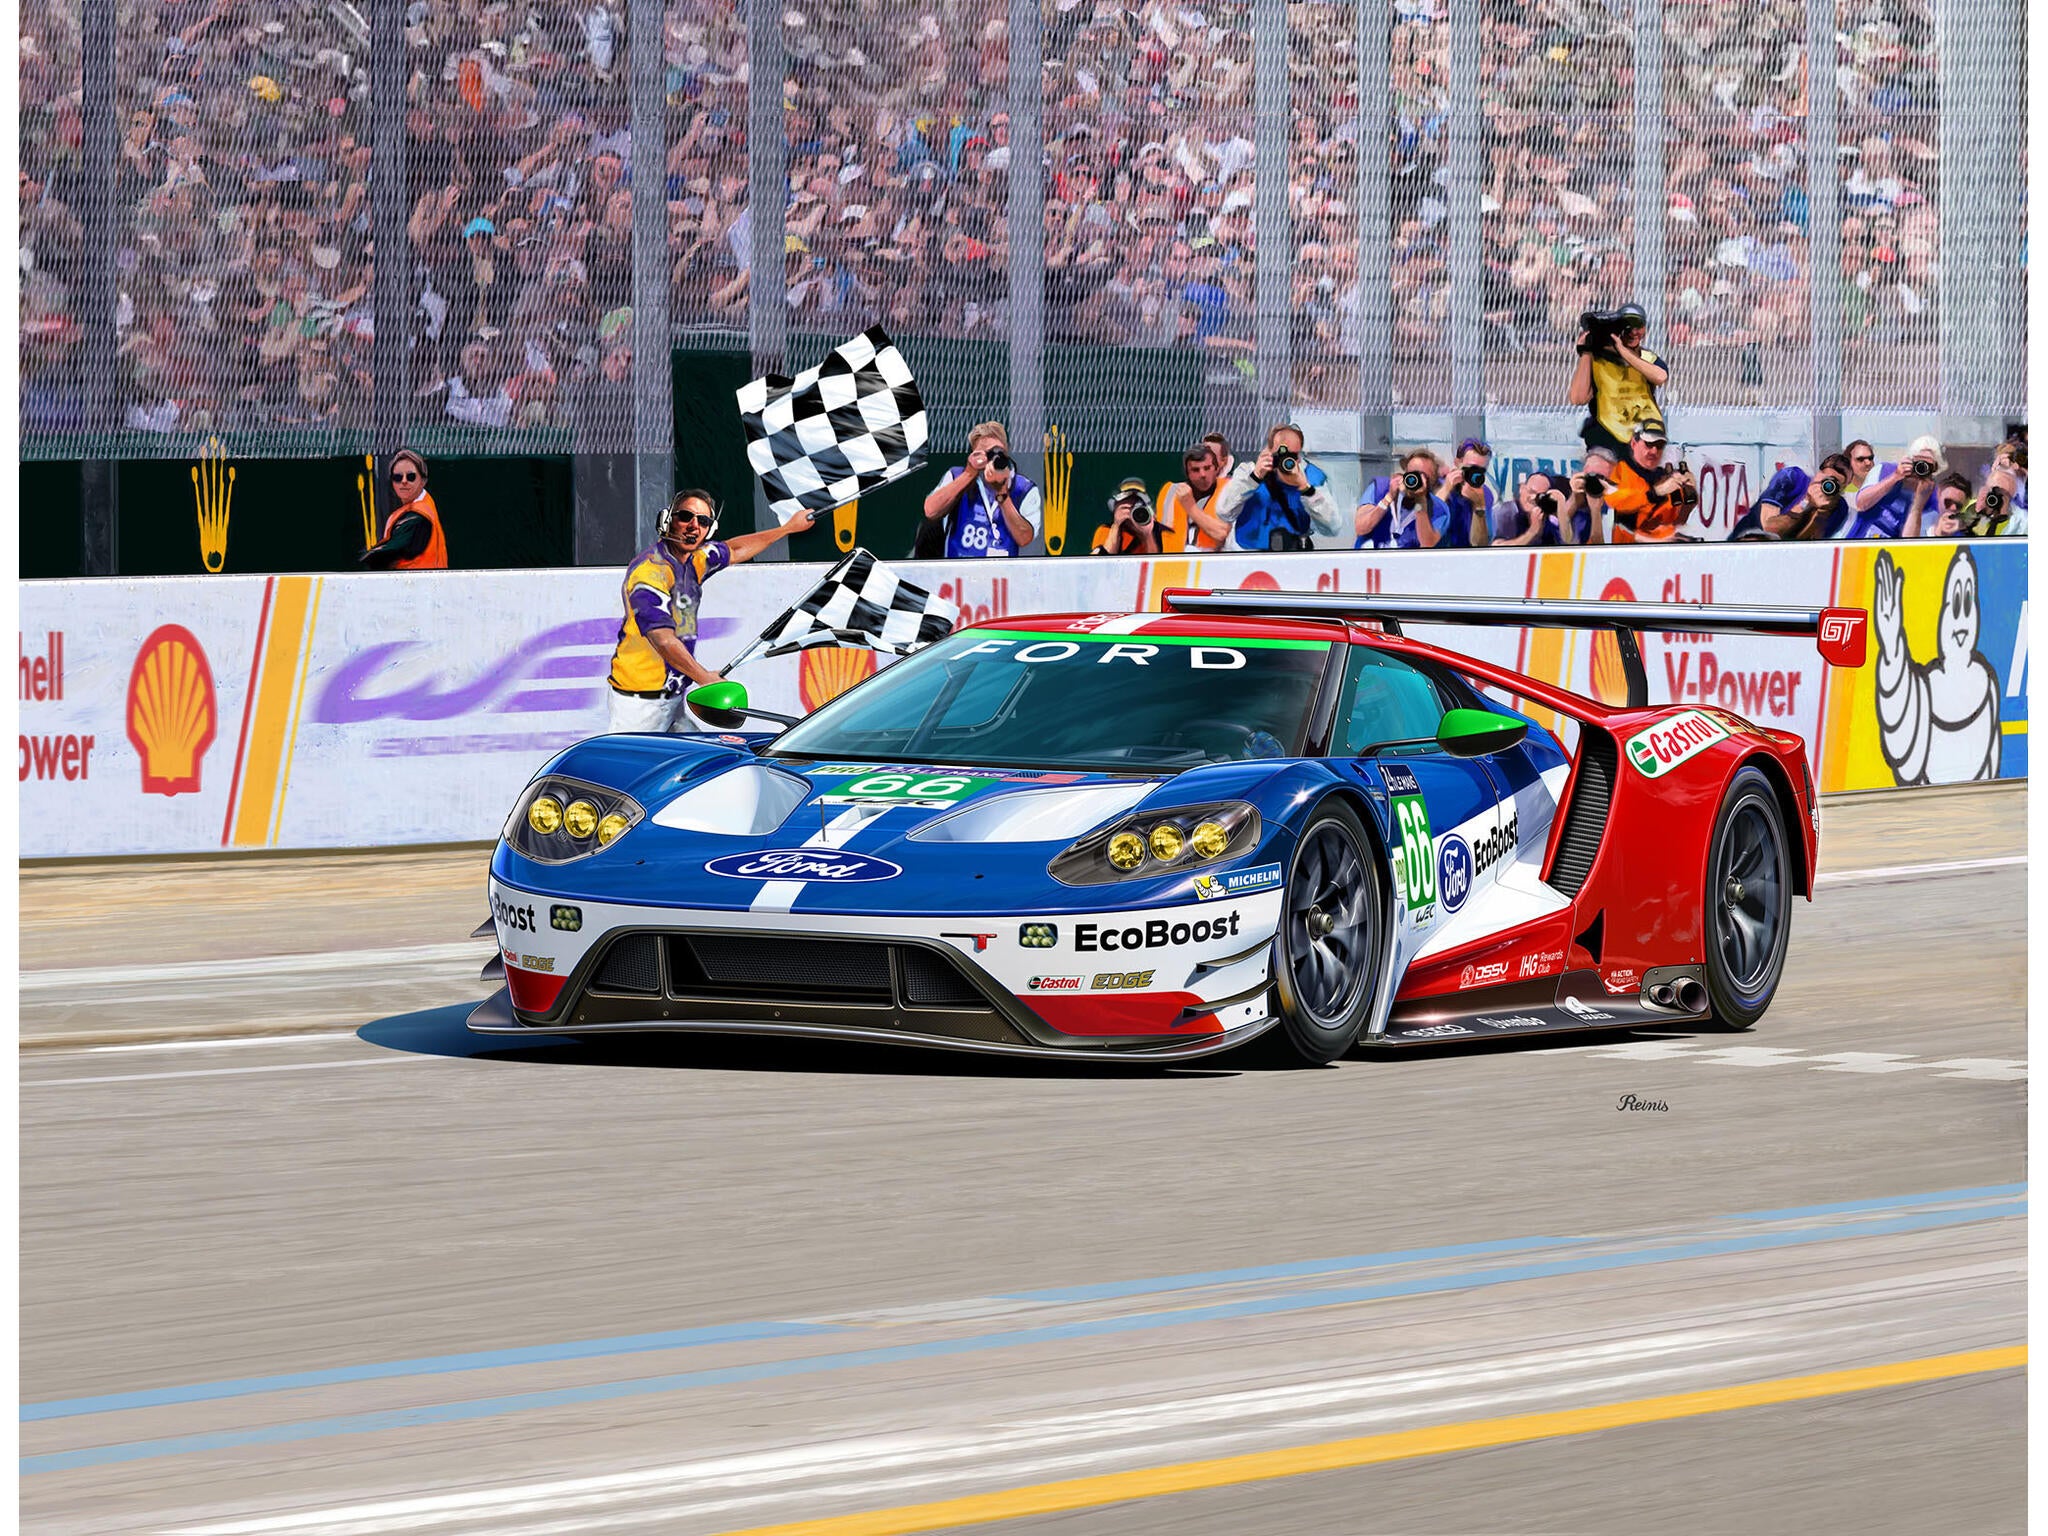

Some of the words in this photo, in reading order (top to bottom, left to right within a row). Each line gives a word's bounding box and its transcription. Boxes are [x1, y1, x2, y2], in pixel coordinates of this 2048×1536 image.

[961, 523, 989, 549] 88
[1821, 616, 1864, 646] GT
[950, 640, 1247, 670] FORD
[1664, 651, 1802, 717] V-Power
[1650, 715, 1720, 763] Castrol
[849, 774, 972, 796] 66
[1397, 800, 1432, 903] 66
[1473, 811, 1519, 877] EcoBoost
[737, 852, 868, 878] Ford
[1444, 846, 1467, 901] Ford
[1228, 869, 1280, 888] MICHELIN
[1075, 910, 1240, 952] EcoBoost
[522, 955, 555, 972] EDGE
[1475, 961, 1509, 980] DSSV
[1519, 954, 1538, 977] IHG
[1538, 963, 1551, 974] Club
[1040, 977, 1080, 989] Castrol
[1091, 970, 1156, 989] EDGE
[1616, 1093, 1669, 1112] Reinis
